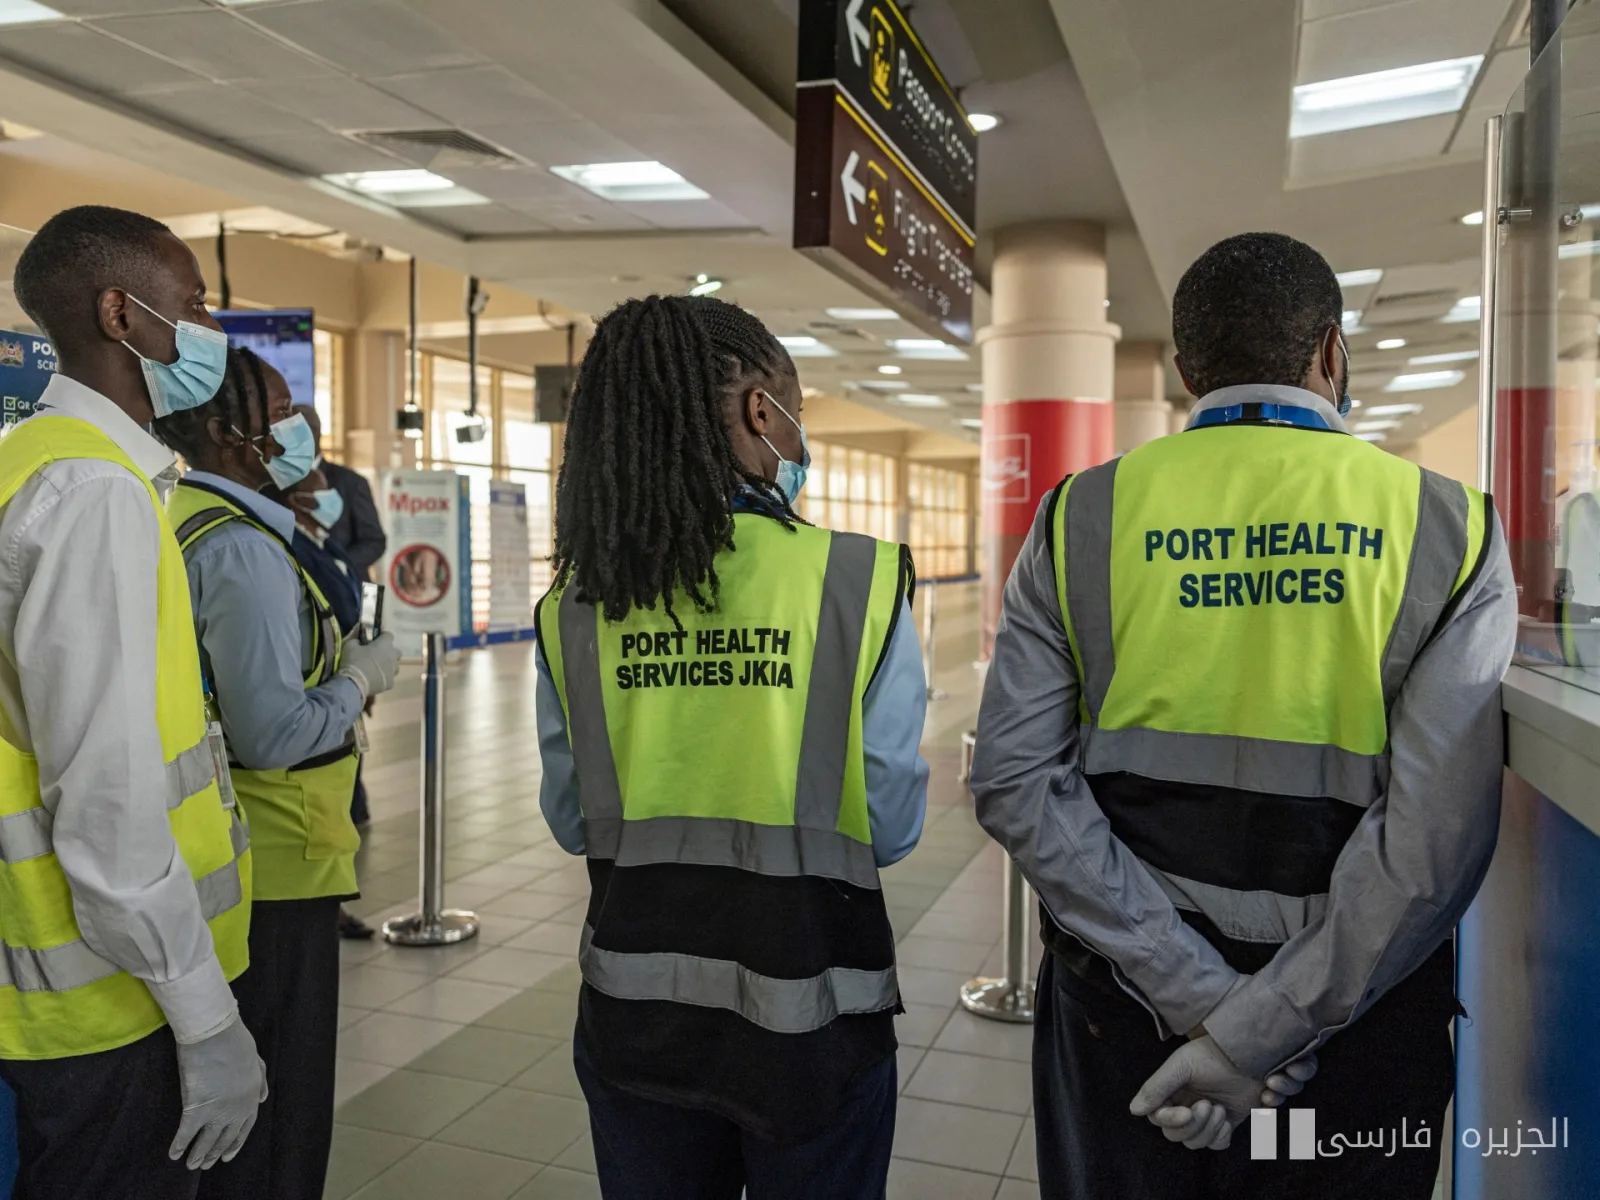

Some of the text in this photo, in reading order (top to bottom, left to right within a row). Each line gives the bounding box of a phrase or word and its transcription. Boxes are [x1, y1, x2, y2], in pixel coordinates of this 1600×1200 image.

[388, 492, 450, 518] Mpox
[1145, 522, 1384, 562] PORT HEALTH
[1178, 568, 1345, 609] SERVICES
[621, 628, 791, 659] PORT HEALTH
[616, 660, 794, 690] SERVICES JKIA
